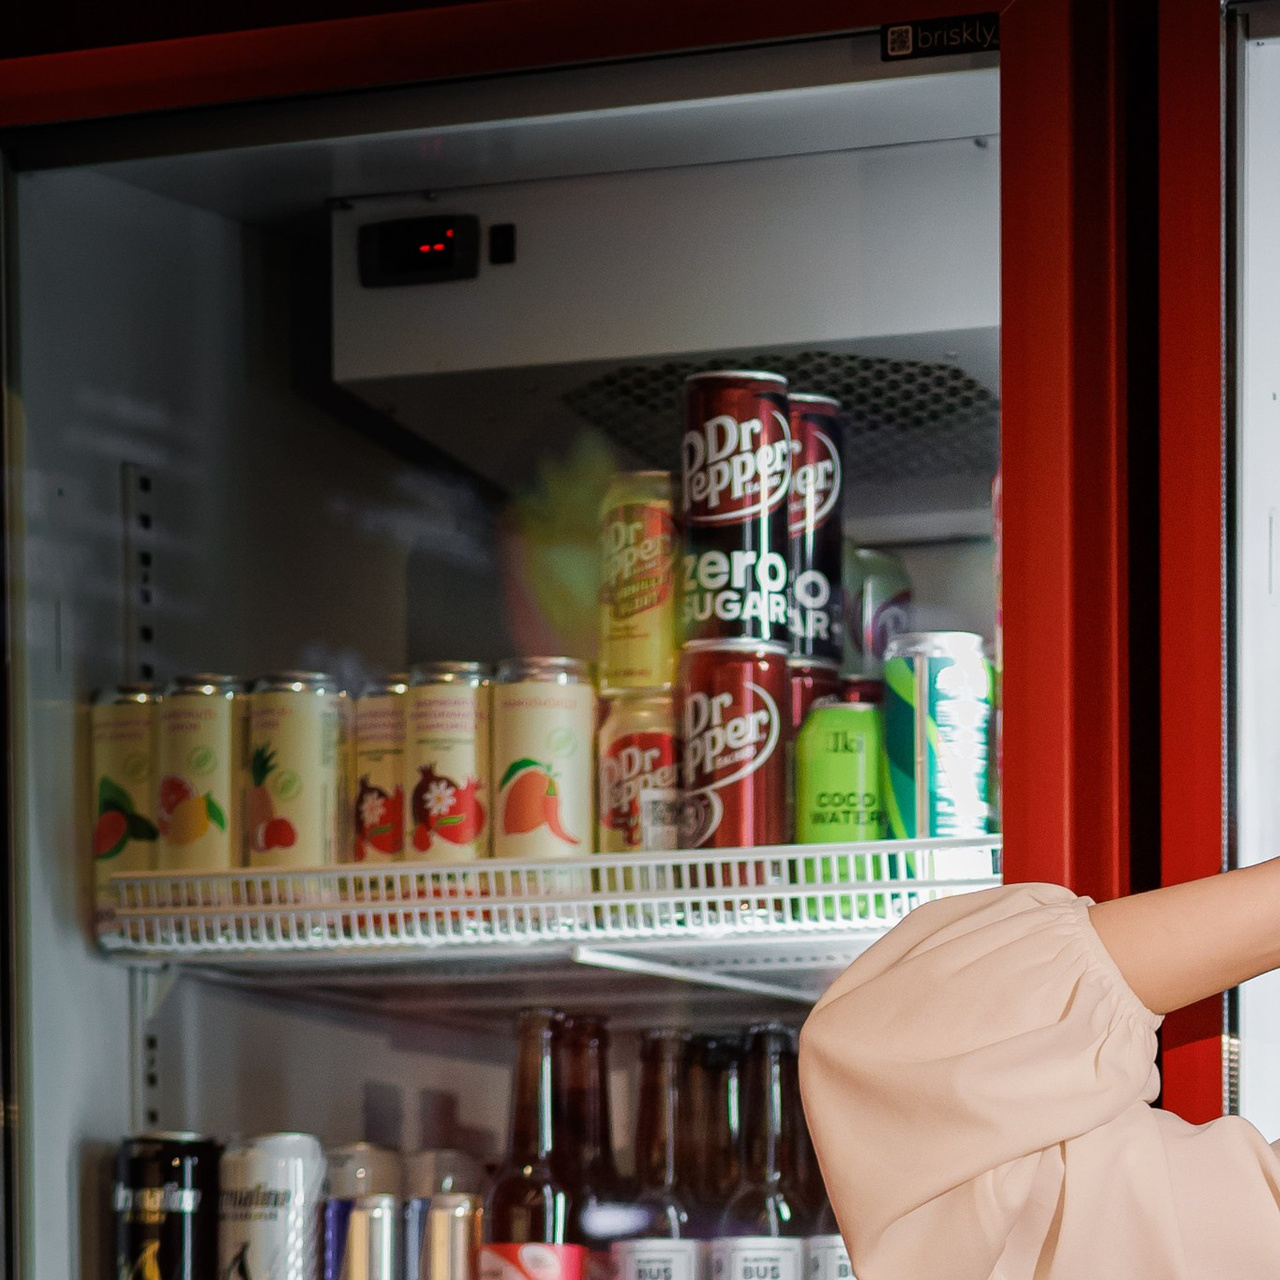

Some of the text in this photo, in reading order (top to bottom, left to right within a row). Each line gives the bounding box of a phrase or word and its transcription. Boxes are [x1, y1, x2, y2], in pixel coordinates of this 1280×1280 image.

[917, 20, 996, 48] briskly
[703, 414, 763, 466] Dr
[680, 428, 803, 512] Pepper
[682, 548, 788, 593] zero
[684, 690, 734, 741] Dr
[620, 746, 661, 780] Dr
[816, 792, 876, 808] COCO
[810, 810, 882, 826] WATER
[742, 1265, 781, 1280] BUS
